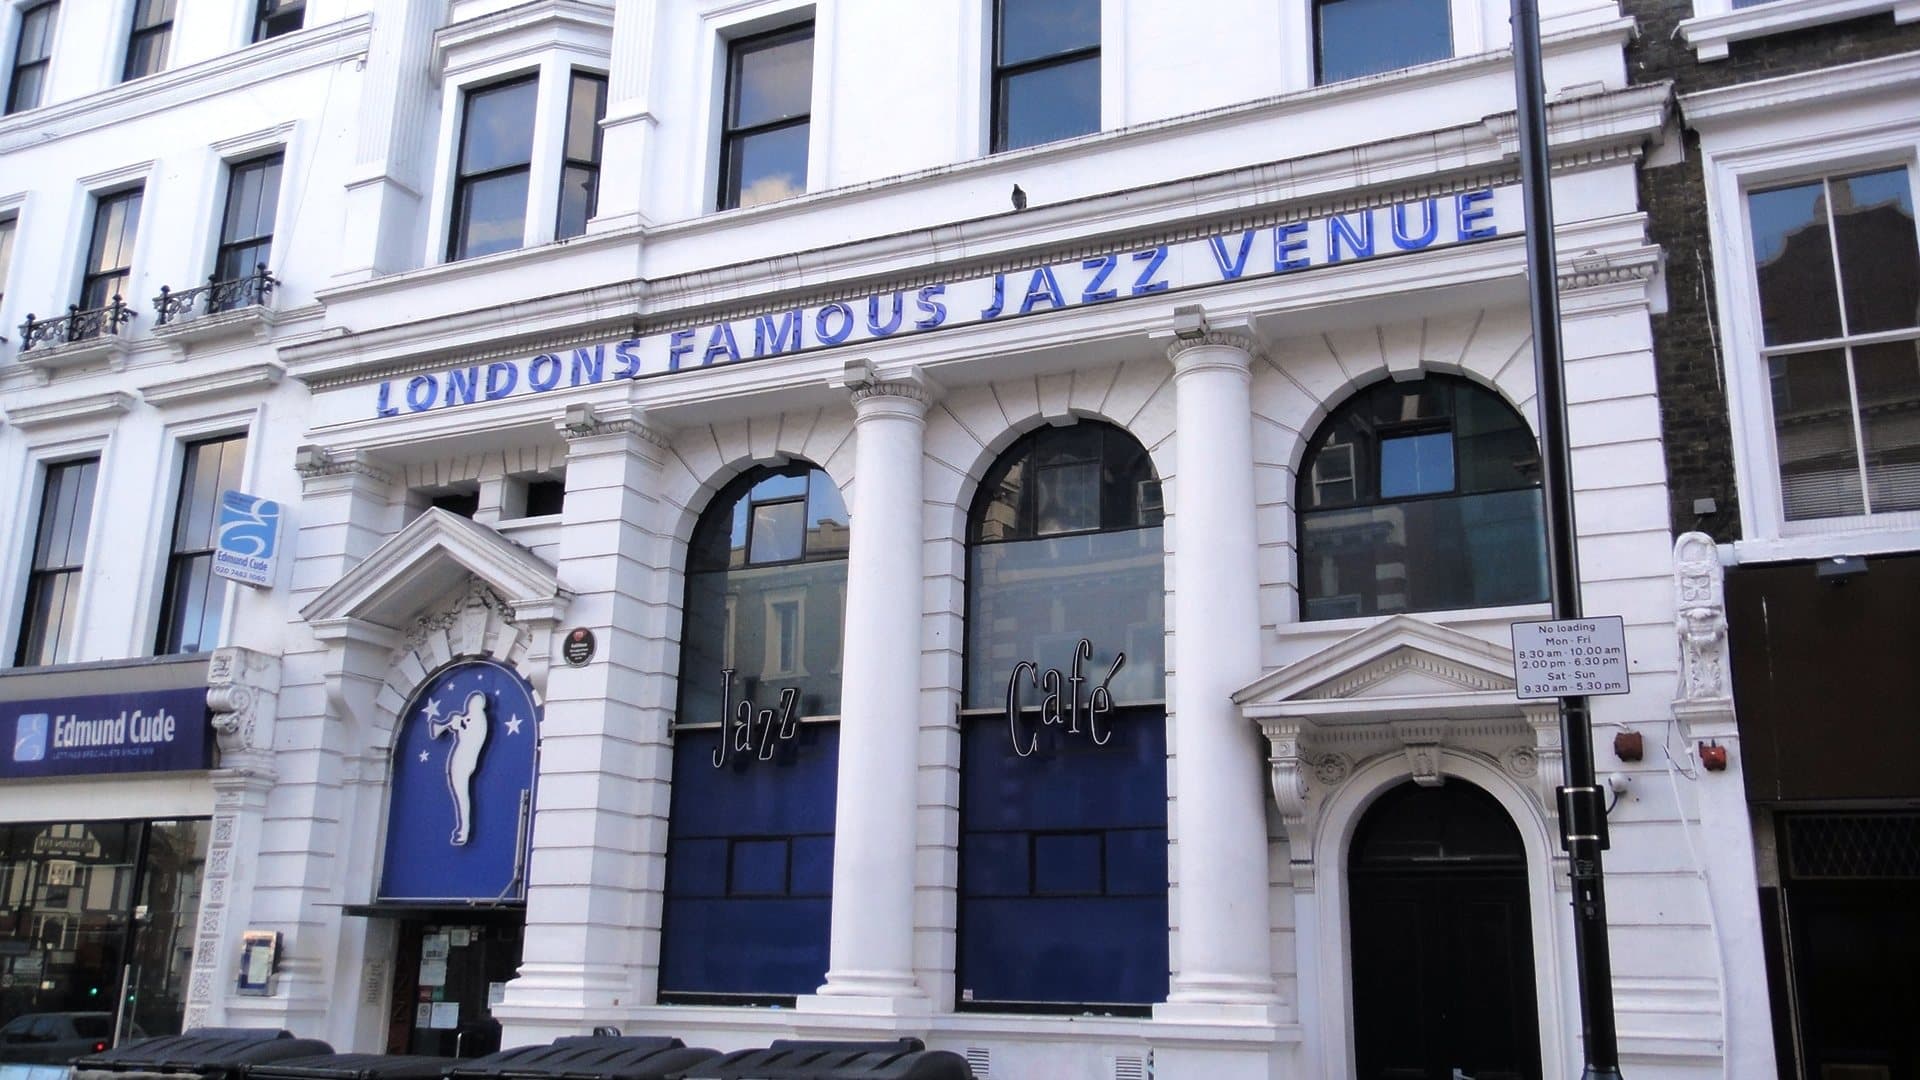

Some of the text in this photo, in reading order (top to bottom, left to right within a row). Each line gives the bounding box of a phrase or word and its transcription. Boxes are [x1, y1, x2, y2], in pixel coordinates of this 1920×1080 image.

[377, 187, 1498, 418] LONDONS FAMOUS JAZZ VENUE
[217, 550, 268, 572] Edmund Cude
[1538, 624, 1596, 634] No loading
[1545, 637, 1569, 646] Mon
[1576, 635, 1592, 645] Fri
[1519, 649, 1545, 659] 8.30
[1546, 650, 1562, 658] am
[1570, 646, 1602, 657] 10.00
[1604, 647, 1621, 655] am
[1521, 659, 1548, 669] 2.00
[1550, 660, 1566, 669] pm
[1574, 656, 1600, 666] 6.30
[1602, 657, 1619, 666] pm
[1547, 671, 1567, 681] Sat
[1574, 670, 1596, 679] Sun
[1524, 683, 1550, 694] 9.30
[1552, 684, 1568, 692] am
[1576, 681, 1602, 691] 5.30
[1604, 682, 1621, 691] pm
[1007, 638, 1125, 758] Café
[712, 669, 797, 769] Jazz
[53, 707, 176, 748] Edmund Cude
